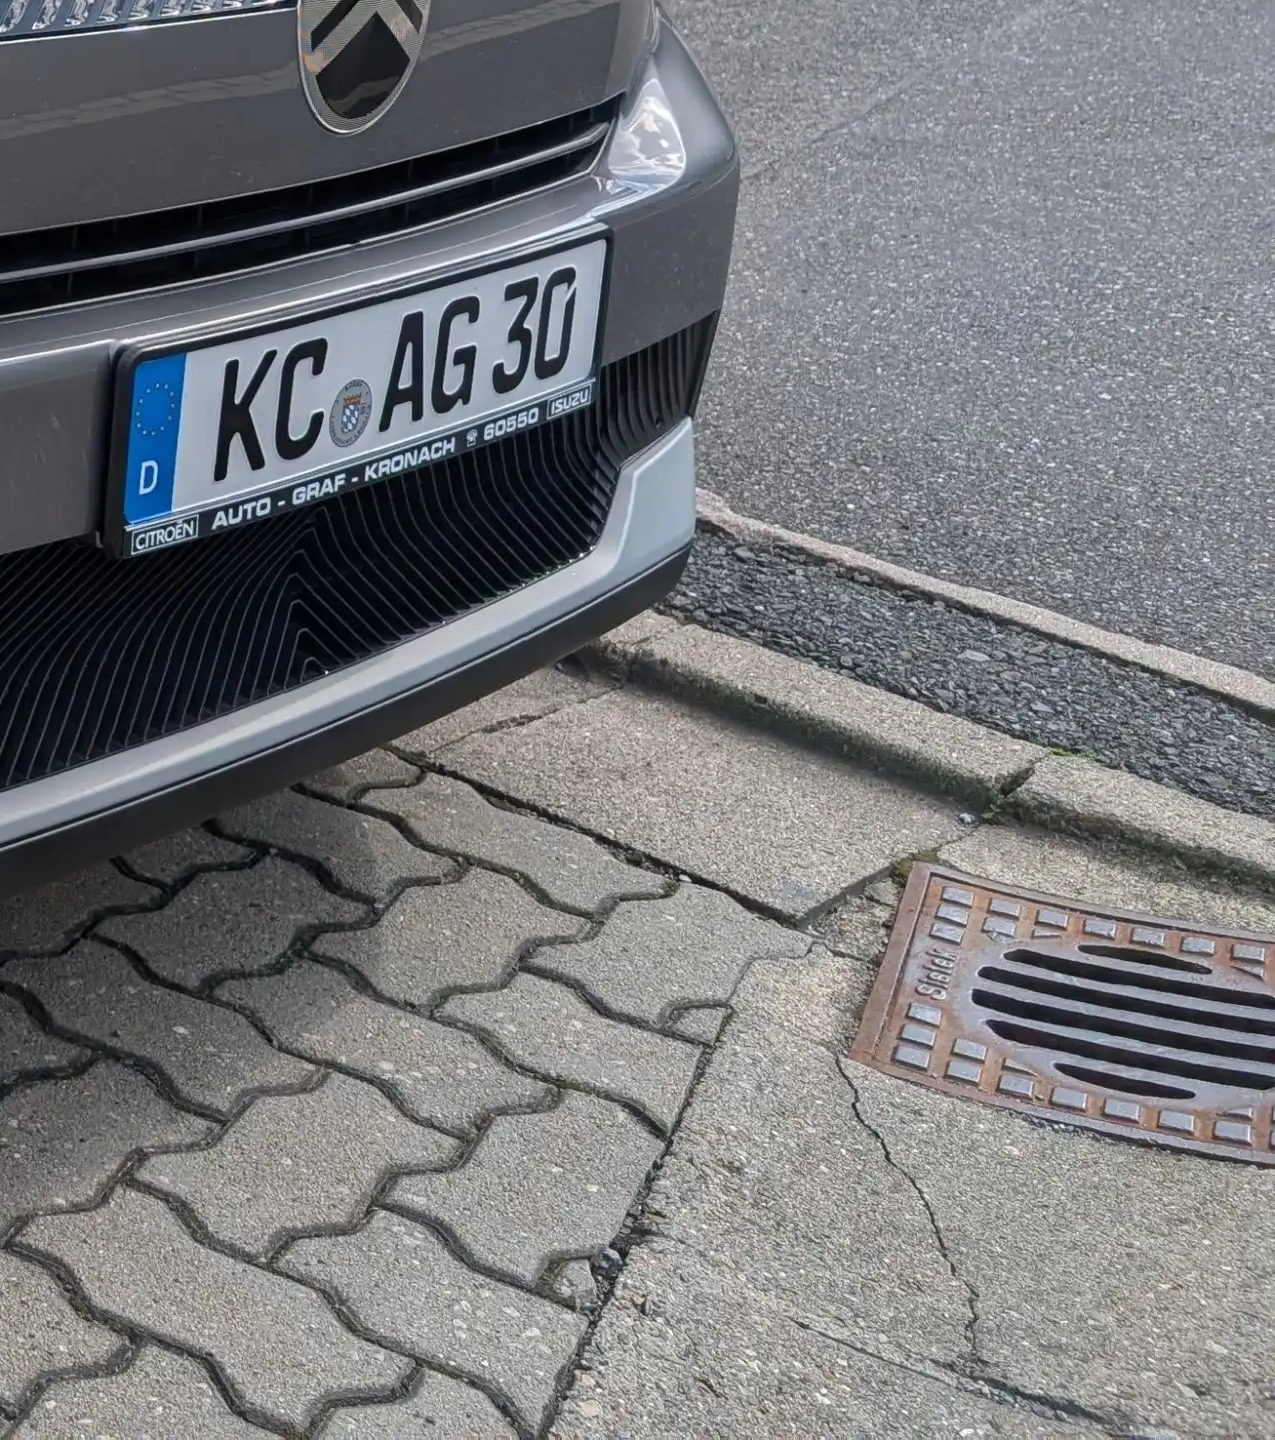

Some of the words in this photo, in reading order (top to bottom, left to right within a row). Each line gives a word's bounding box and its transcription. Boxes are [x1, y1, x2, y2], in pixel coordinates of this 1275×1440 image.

[213, 336, 329, 482] KC
[550, 388, 589, 415] ISUZU
[138, 459, 159, 496] D
[211, 497, 271, 531] AUTO
[291, 473, 346, 506] GRAF
[364, 439, 456, 482] KRONACH
[483, 408, 540, 441] 60550
[134, 517, 194, 551] CITROËN
